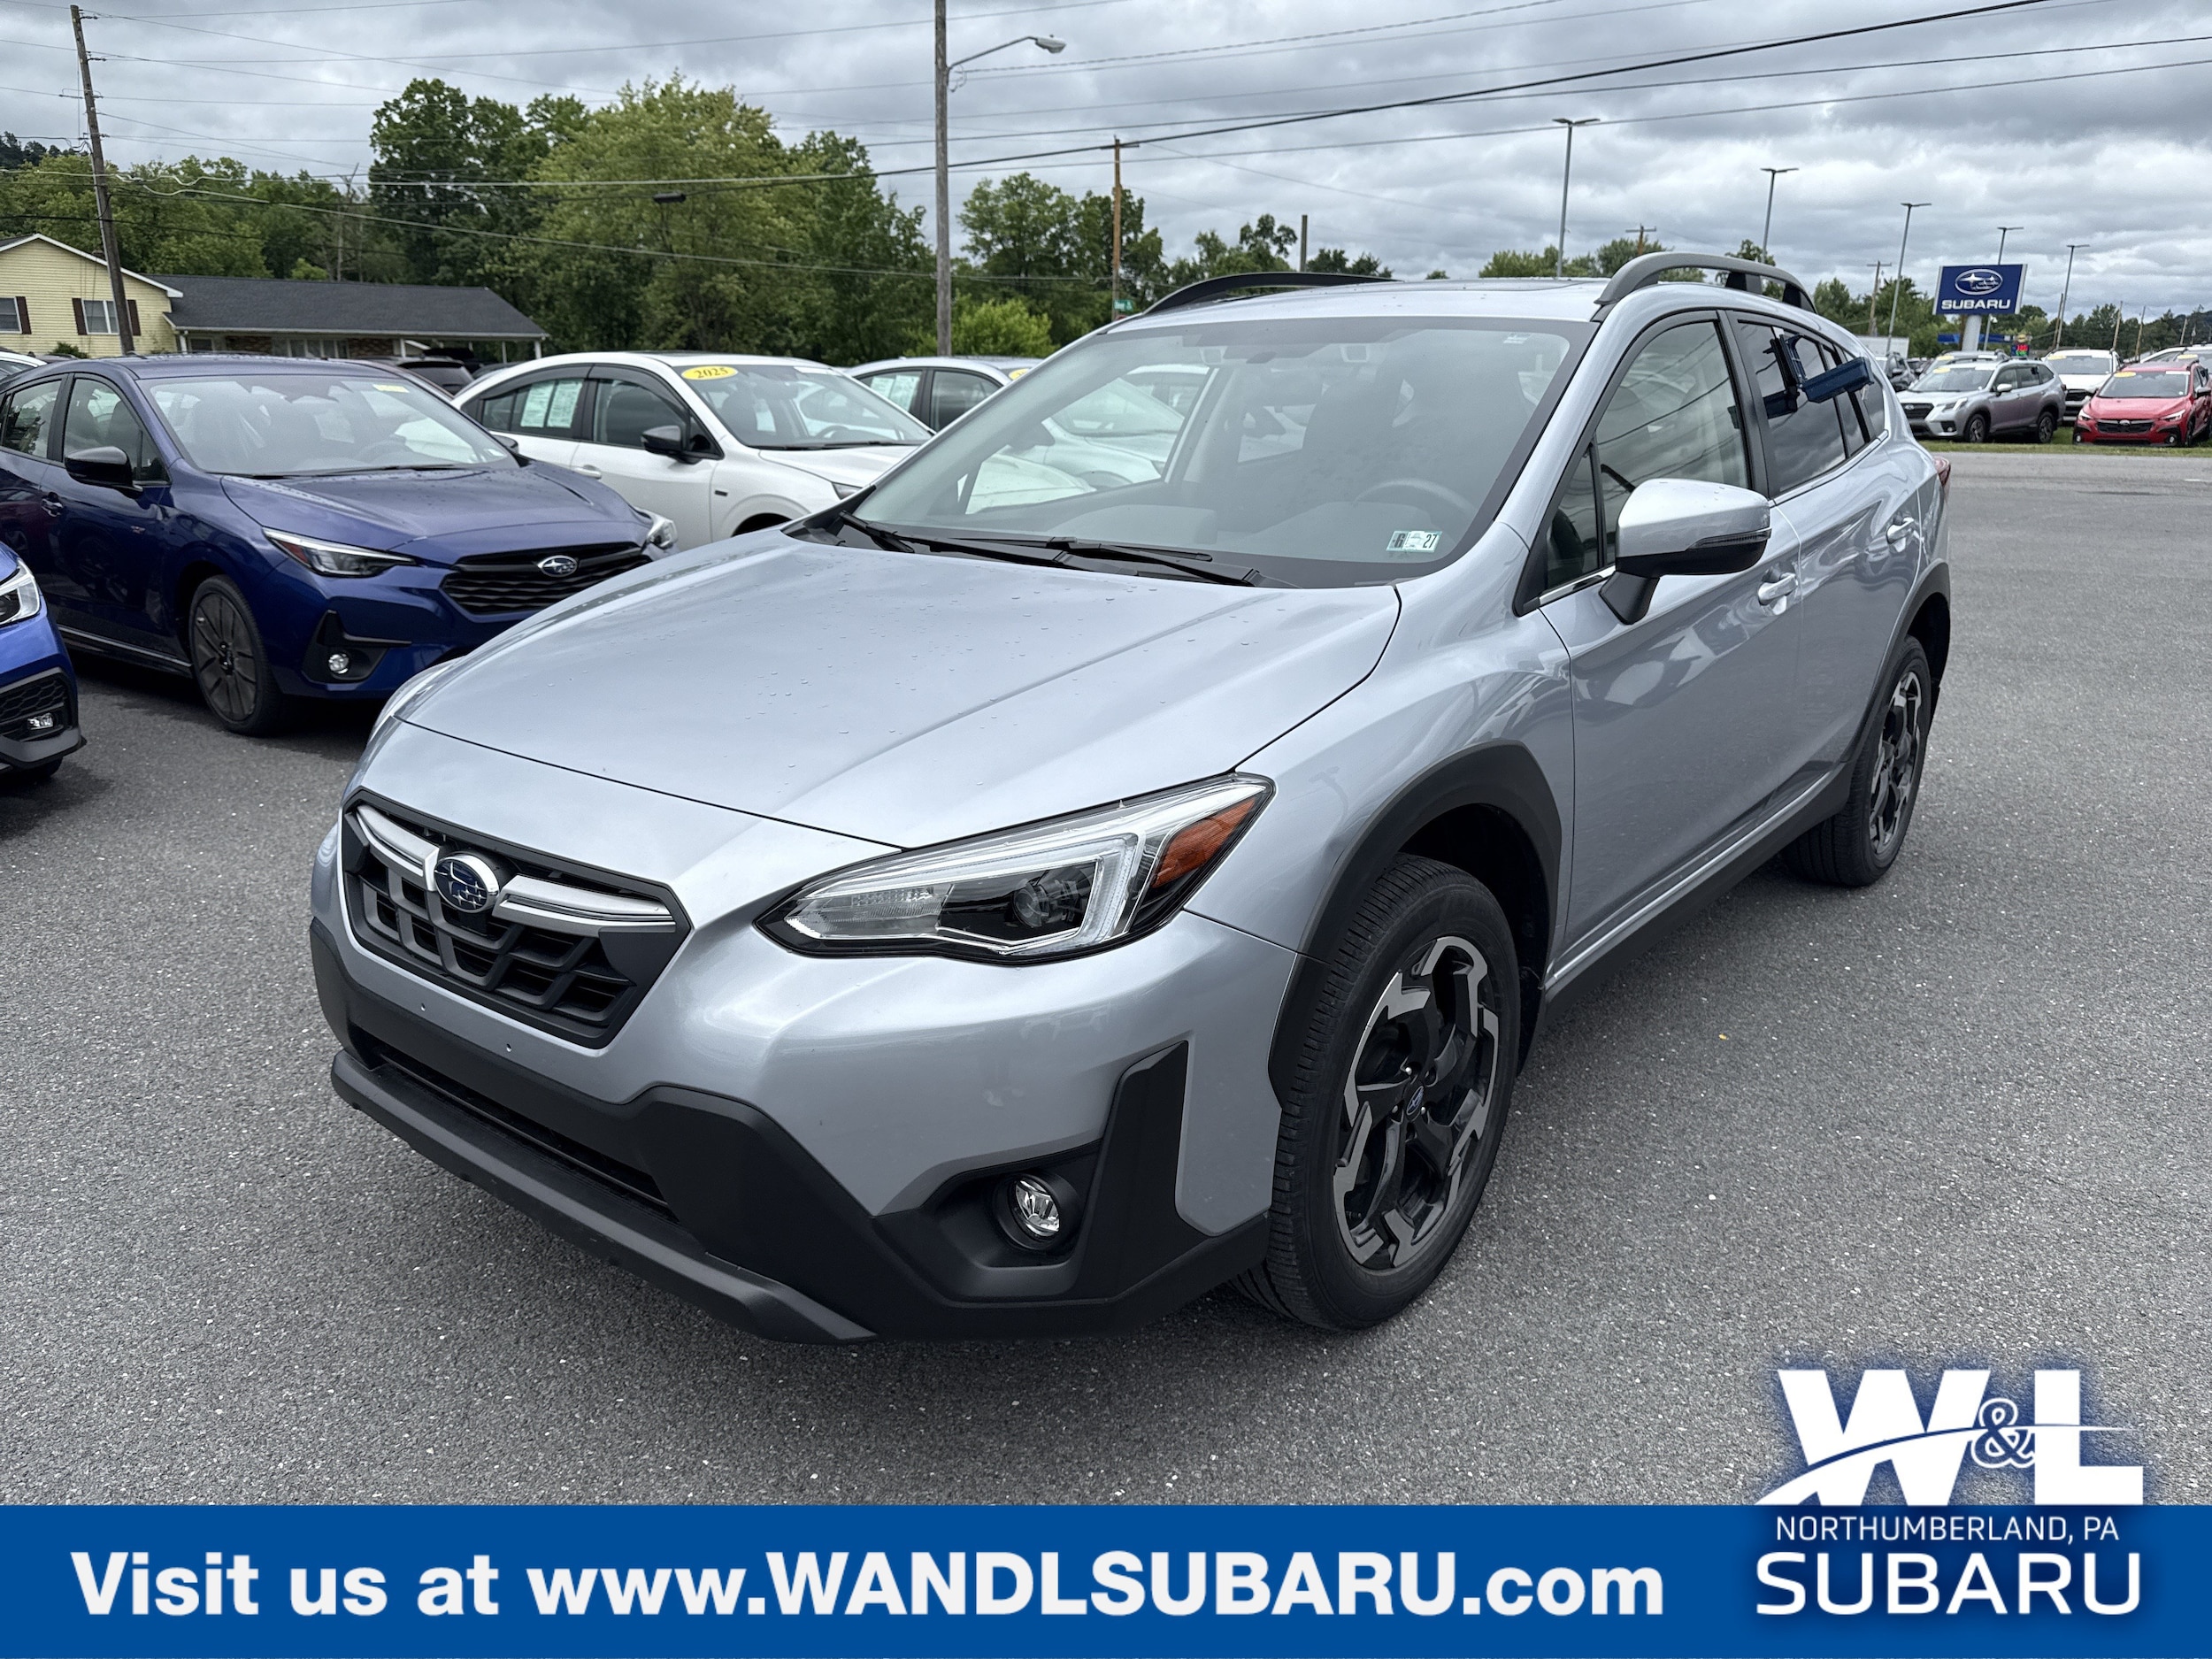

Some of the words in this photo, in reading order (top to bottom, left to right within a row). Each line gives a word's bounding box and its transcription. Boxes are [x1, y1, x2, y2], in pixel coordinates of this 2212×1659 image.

[1941, 299, 2010, 310] SUBARU
[694, 367, 729, 379] 2025
[1422, 534, 1437, 549] 27
